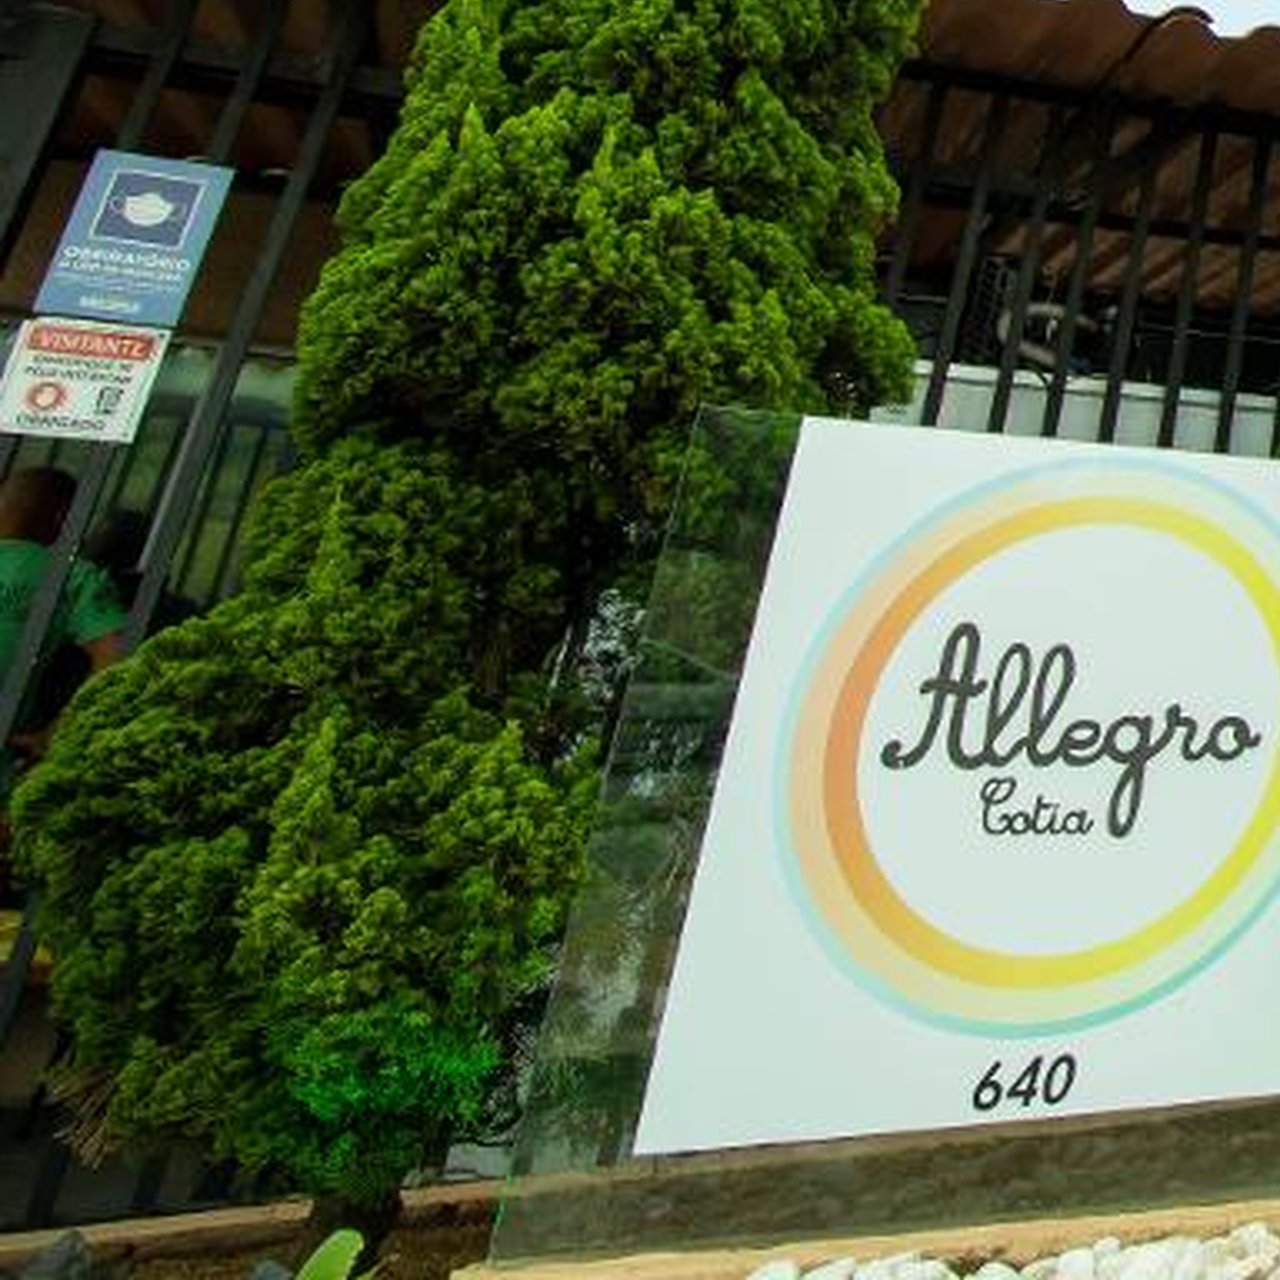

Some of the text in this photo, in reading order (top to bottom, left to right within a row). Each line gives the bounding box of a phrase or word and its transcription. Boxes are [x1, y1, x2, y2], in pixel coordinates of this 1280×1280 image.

[880, 622, 1263, 839] Allegro
[979, 776, 1095, 836] Cotia
[972, 1053, 1078, 1112] 640
